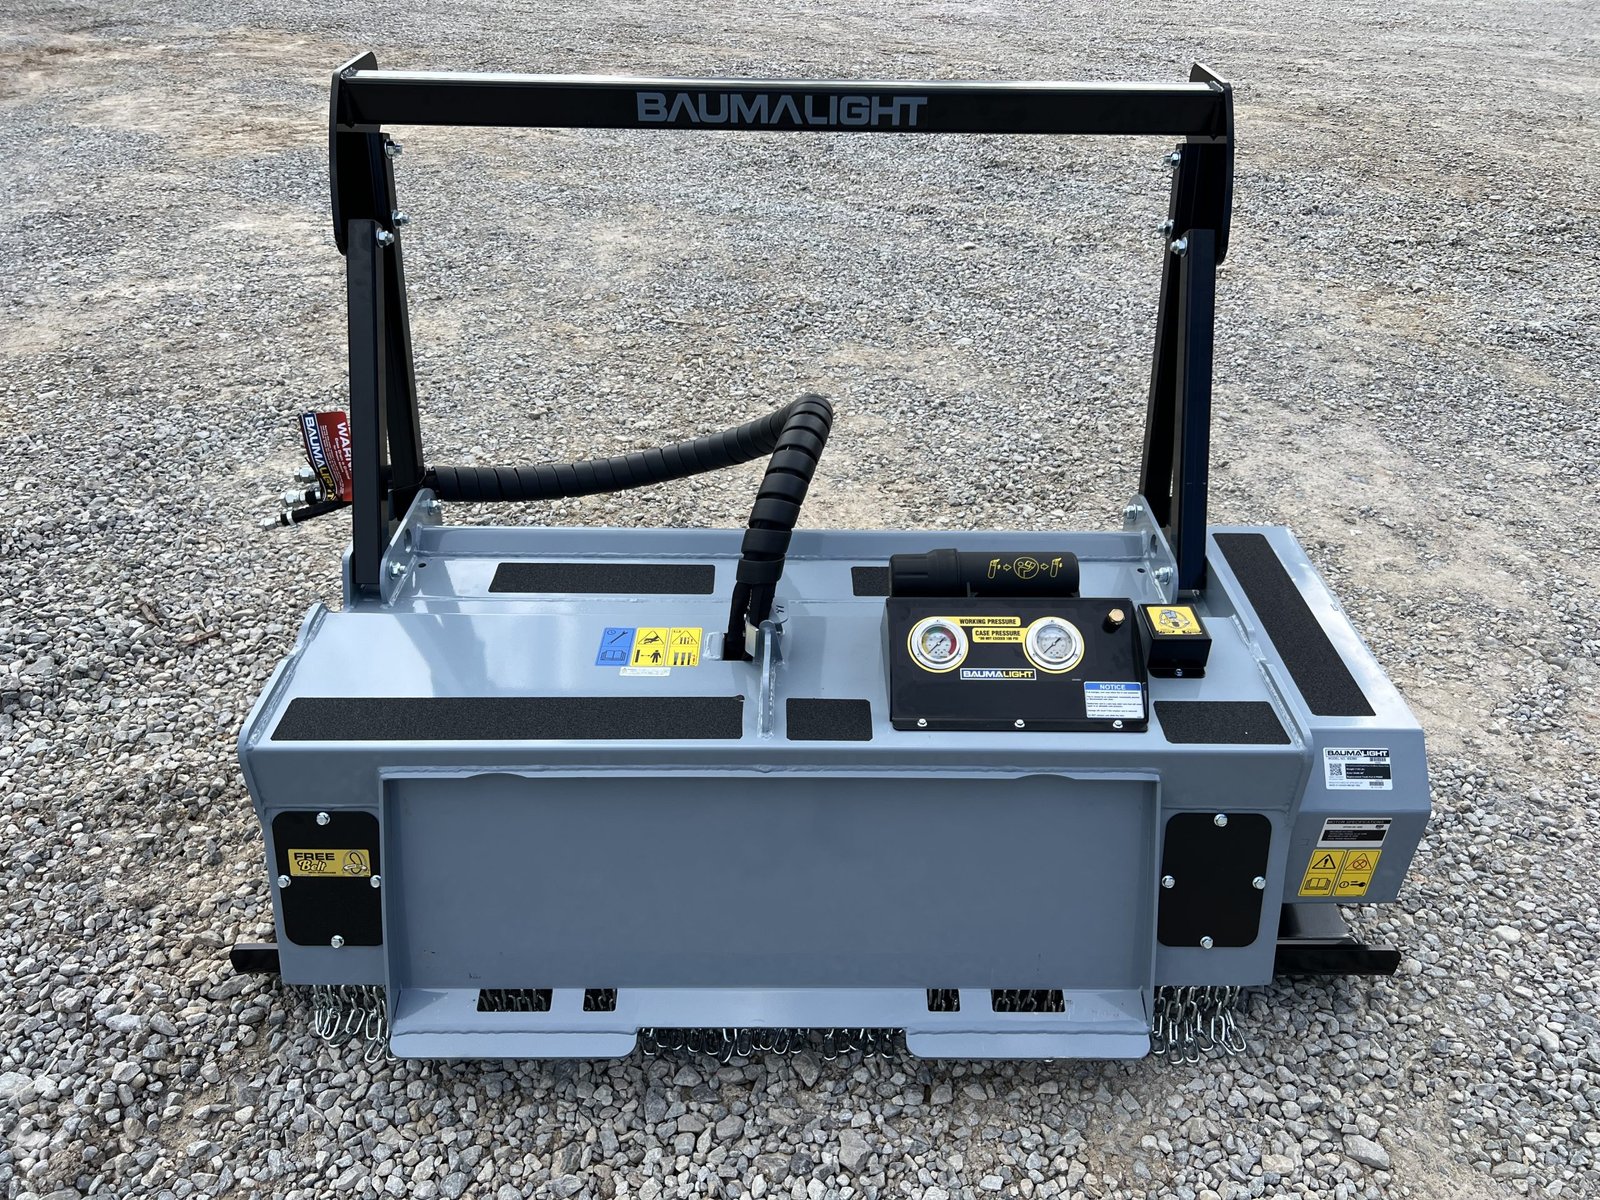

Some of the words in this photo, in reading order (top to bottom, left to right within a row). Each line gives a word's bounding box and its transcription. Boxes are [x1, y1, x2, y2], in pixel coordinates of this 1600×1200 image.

[636, 92, 928, 126] BAUMALIGHT
[963, 670, 1034, 678] BAUMALIGHT
[297, 860, 327, 871] Belt
